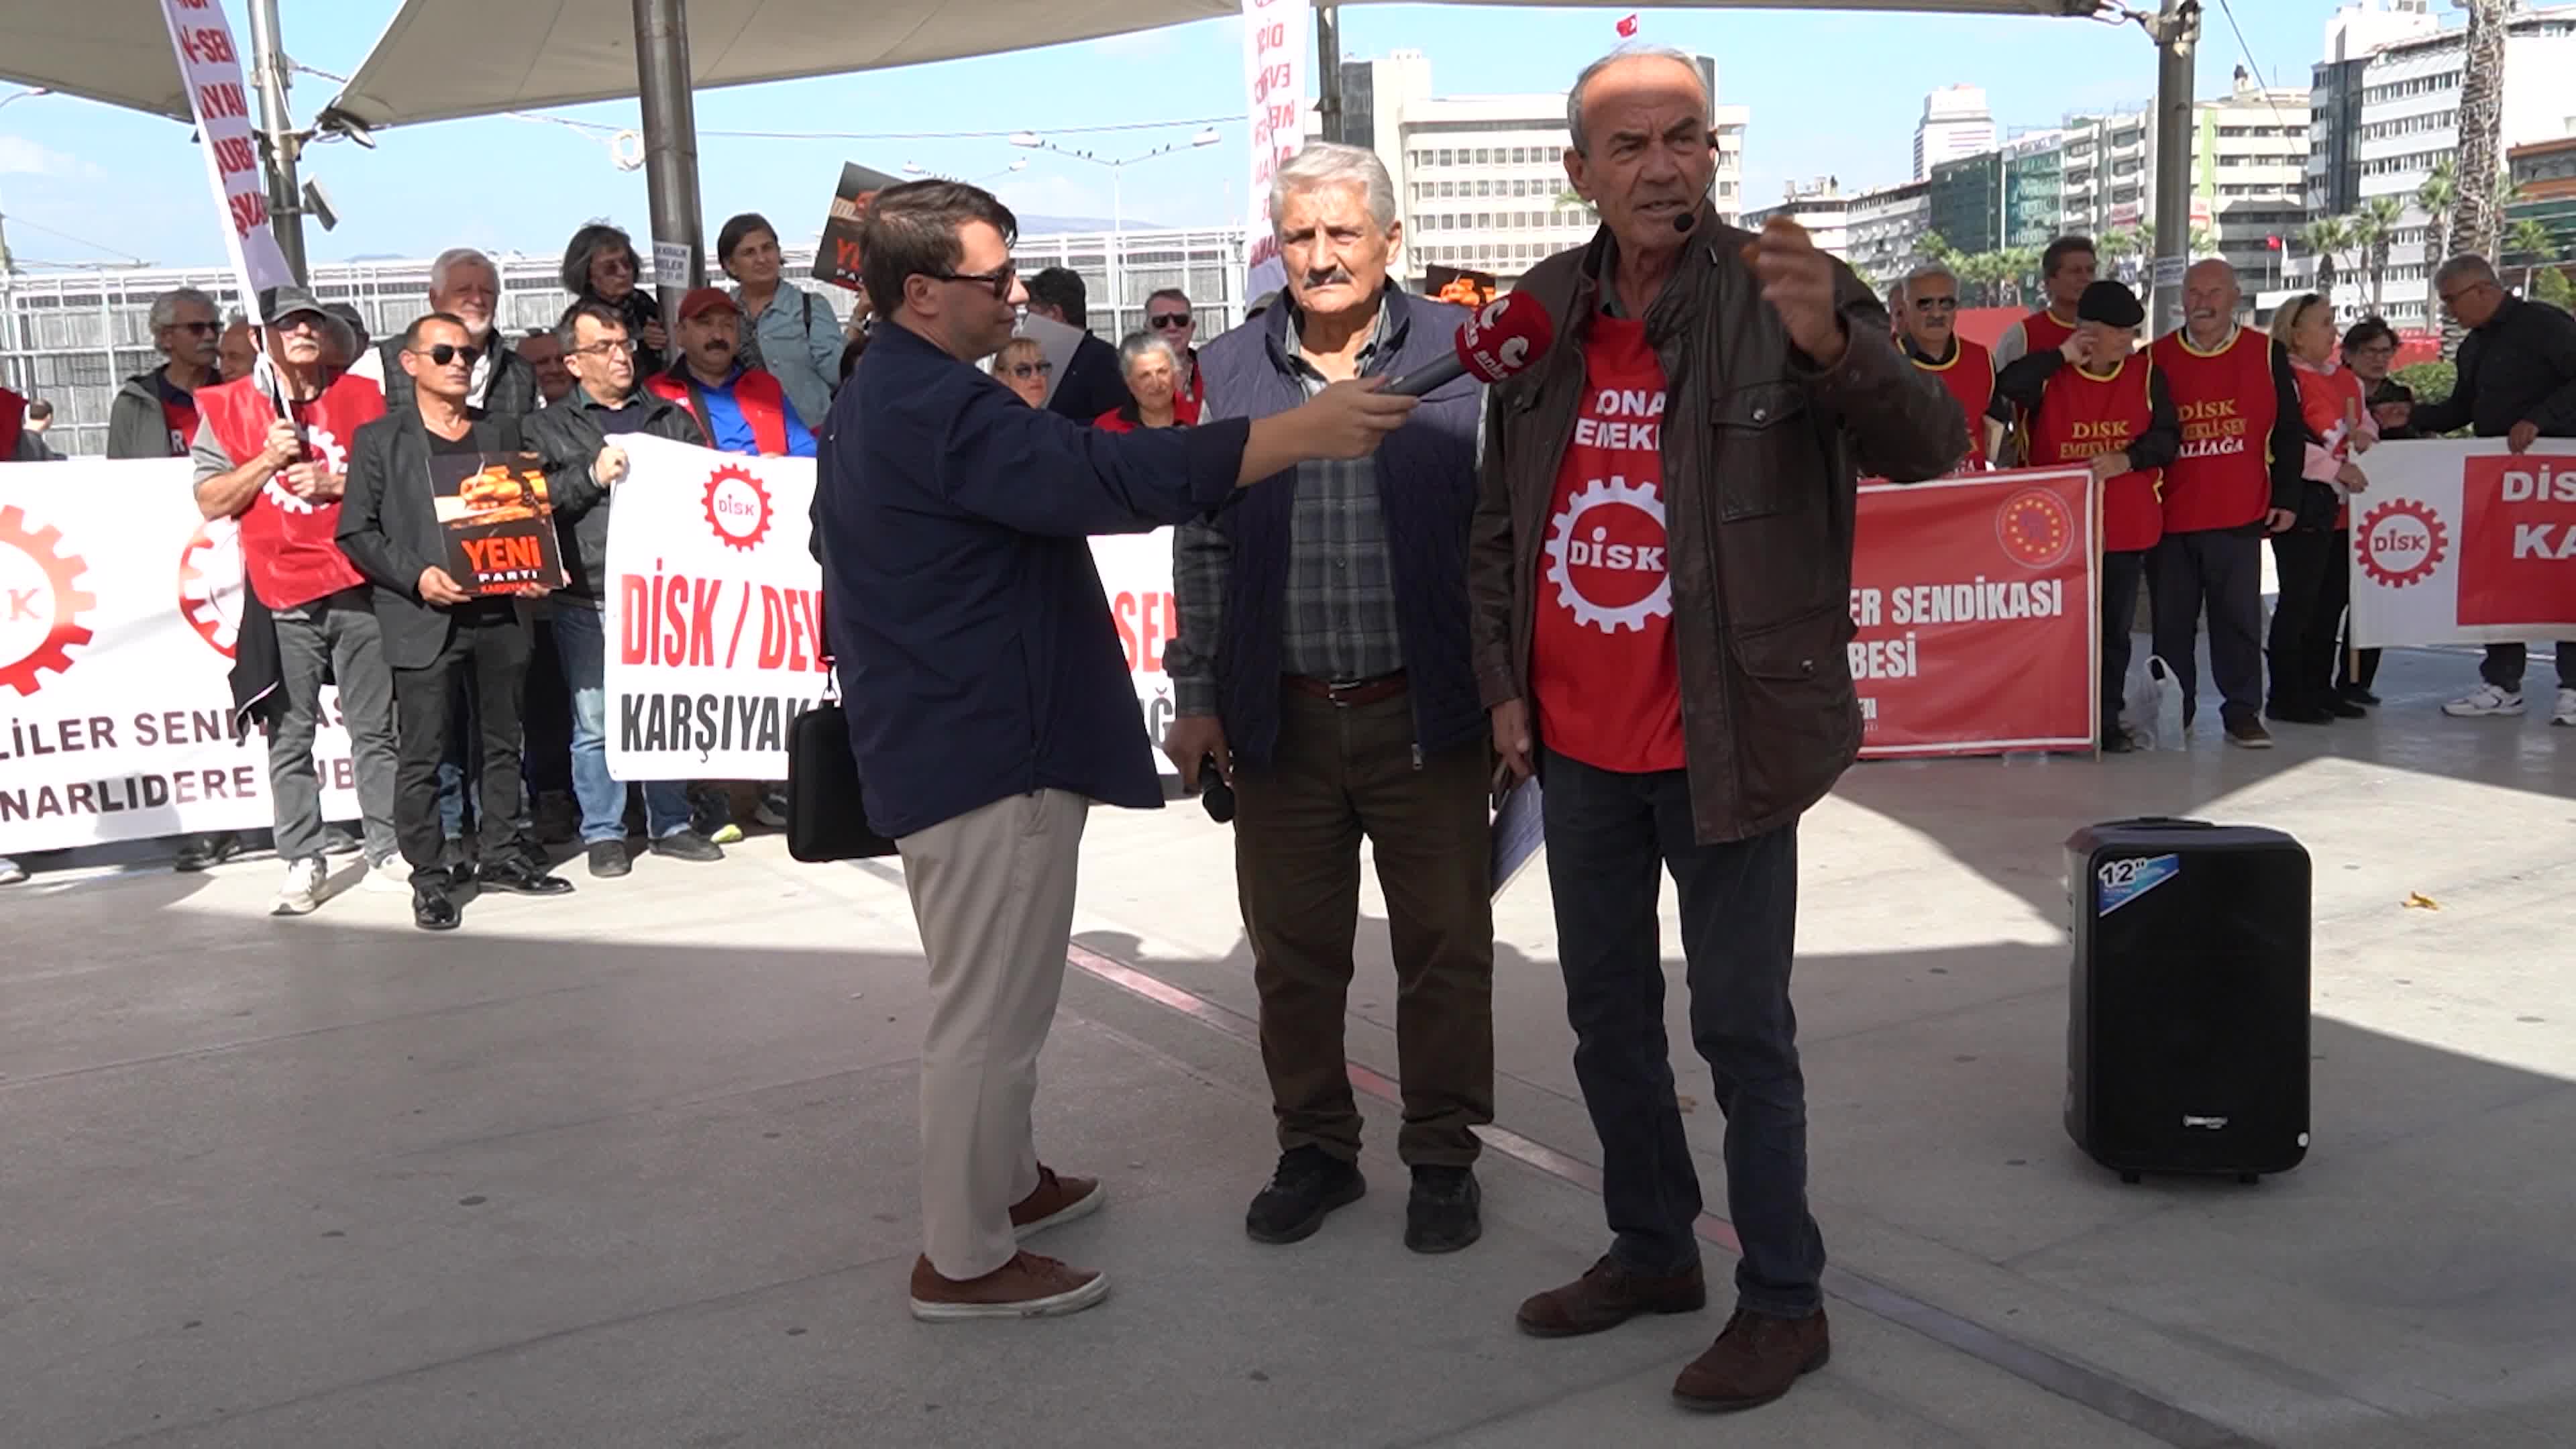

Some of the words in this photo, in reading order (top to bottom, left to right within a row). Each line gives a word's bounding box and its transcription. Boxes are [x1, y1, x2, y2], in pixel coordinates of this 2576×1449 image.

[1595, 388, 1666, 417] ONA
[718, 494, 755, 516] DİSK
[1568, 526, 1665, 572] DİSK
[2375, 528, 2426, 551] DİSK
[621, 557, 722, 667] DİSK
[1891, 576, 2062, 625] SENDİKASI
